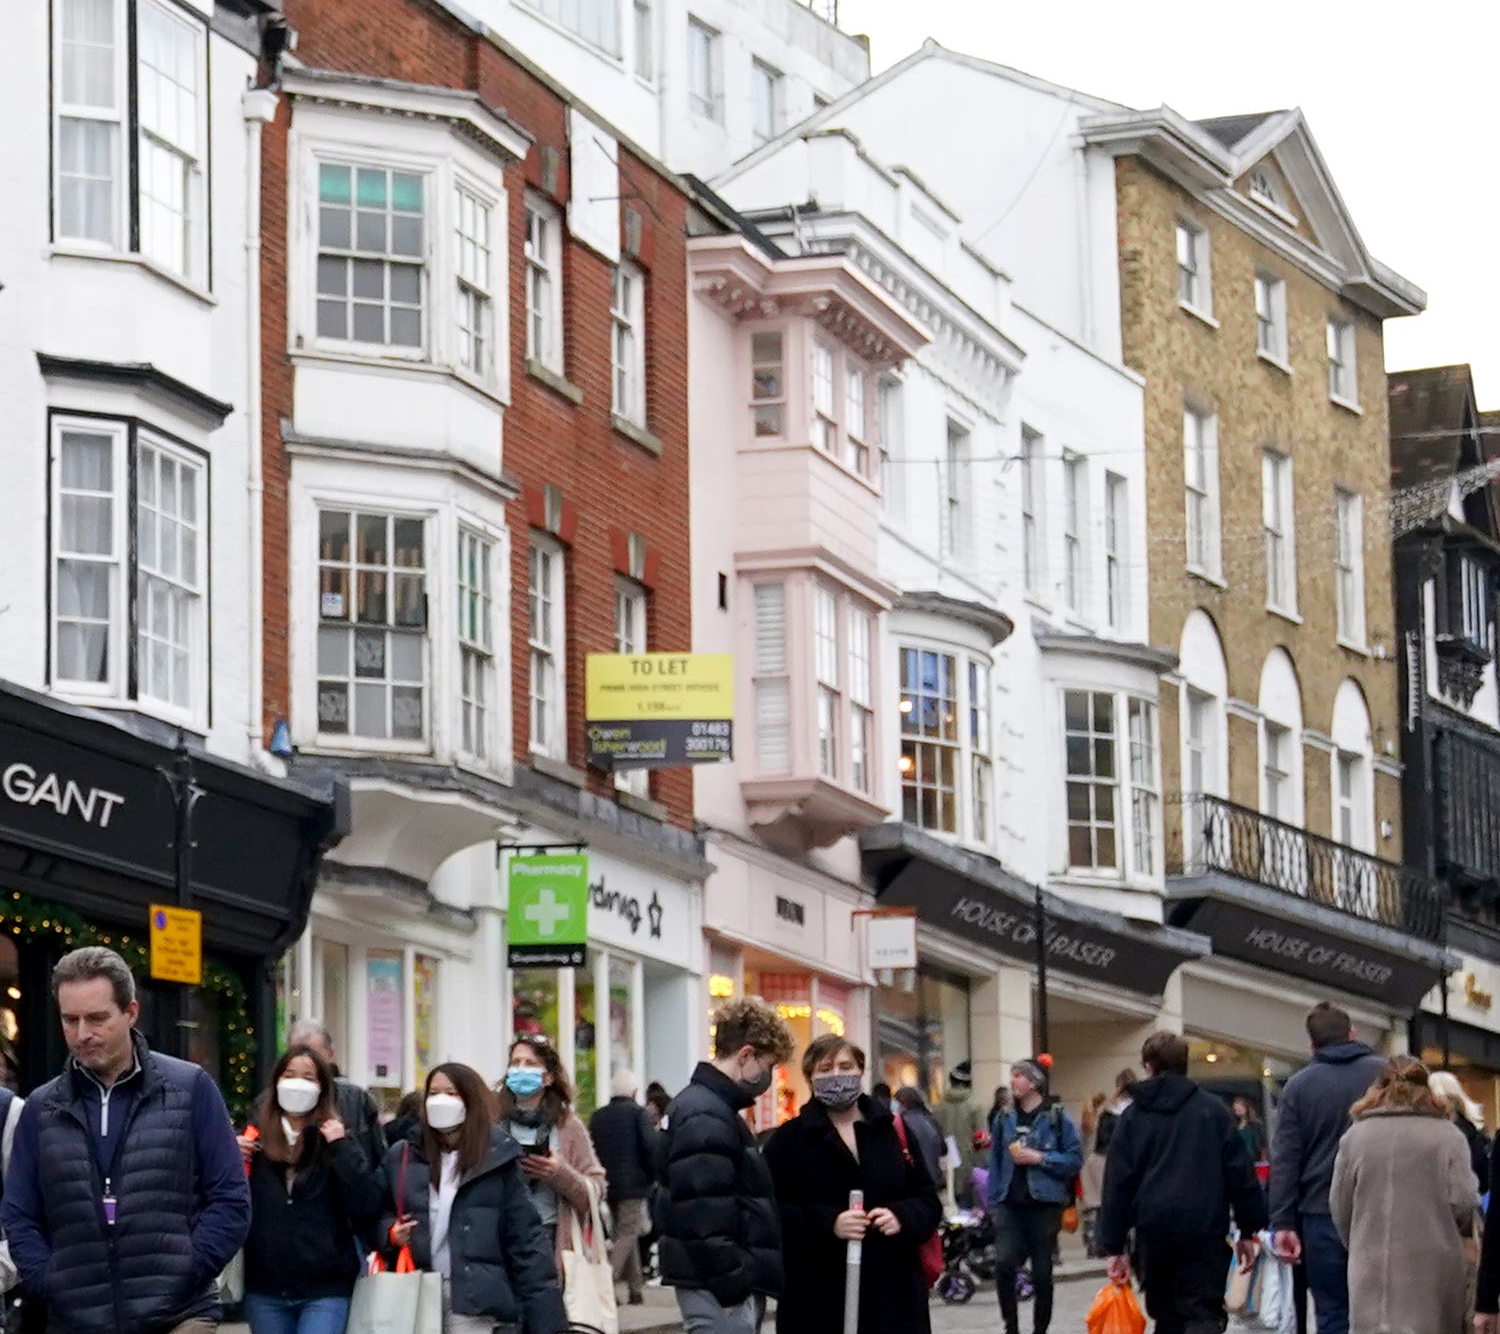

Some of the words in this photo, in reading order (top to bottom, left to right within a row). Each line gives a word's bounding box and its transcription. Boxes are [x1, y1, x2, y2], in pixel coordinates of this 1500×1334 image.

[631, 659, 653, 676] TO
[658, 659, 688, 676] LET
[2, 763, 125, 827] GANT
[950, 896, 1015, 937] HOUSE
[1245, 924, 1312, 960] HOUSE
[1307, 945, 1337, 966] OF
[1331, 952, 1393, 985] FRASER
